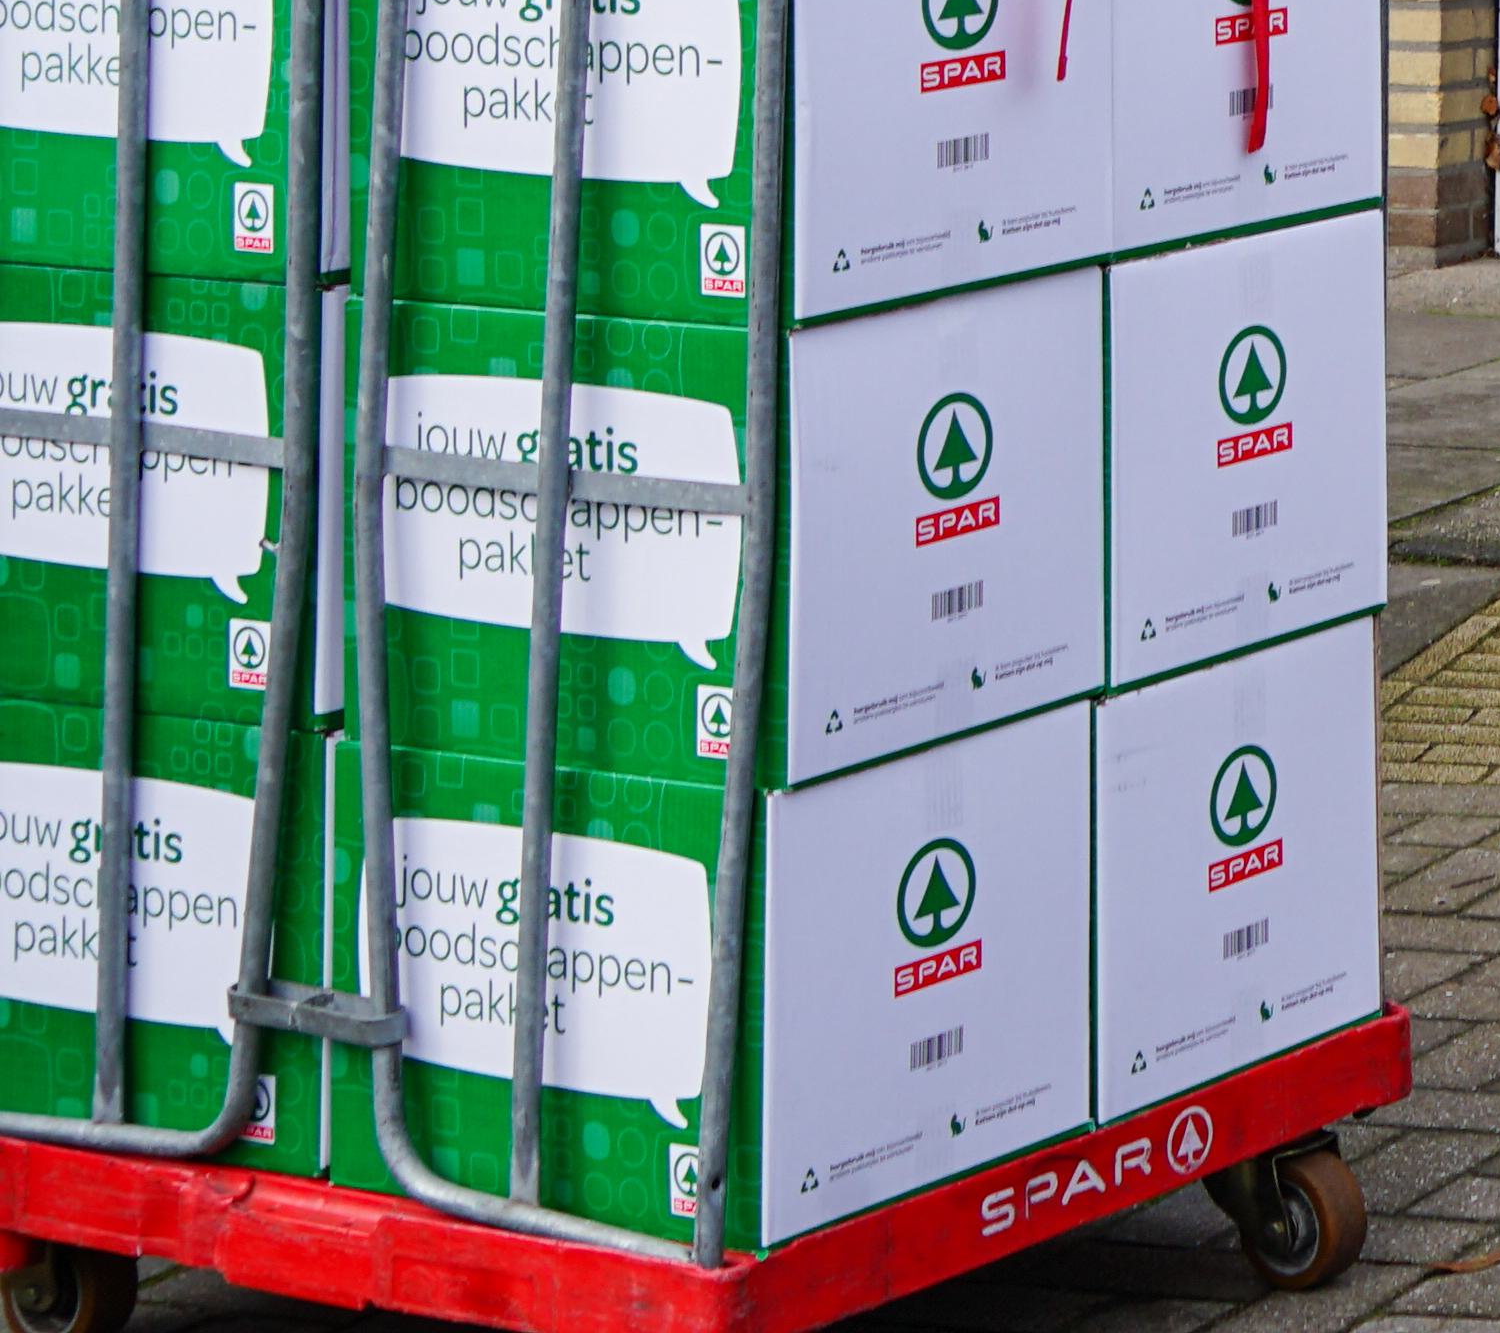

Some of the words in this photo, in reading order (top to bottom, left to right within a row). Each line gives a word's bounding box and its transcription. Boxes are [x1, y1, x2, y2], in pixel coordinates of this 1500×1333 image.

[21, 42, 120, 93] pakke
[922, 56, 1002, 90] SPAR
[464, 77, 594, 129] pakkt
[236, 236, 271, 250] SPAR
[704, 278, 743, 292] SPAR
[516, 426, 639, 474] gatis
[1218, 427, 1290, 466] SPAR
[12, 472, 112, 520] pakke
[917, 501, 998, 545] SPAR
[459, 531, 591, 582] paket
[700, 740, 729, 754] SPA
[69, 819, 184, 863] grtis
[396, 854, 488, 909] jouw
[496, 878, 616, 927] gatis
[1210, 844, 1282, 890] SPAR
[14, 917, 137, 968] pakkt
[396, 922, 695, 997] oodscappen-
[896, 944, 981, 995] SPAR
[981, 1137, 1152, 1238] SPAR
